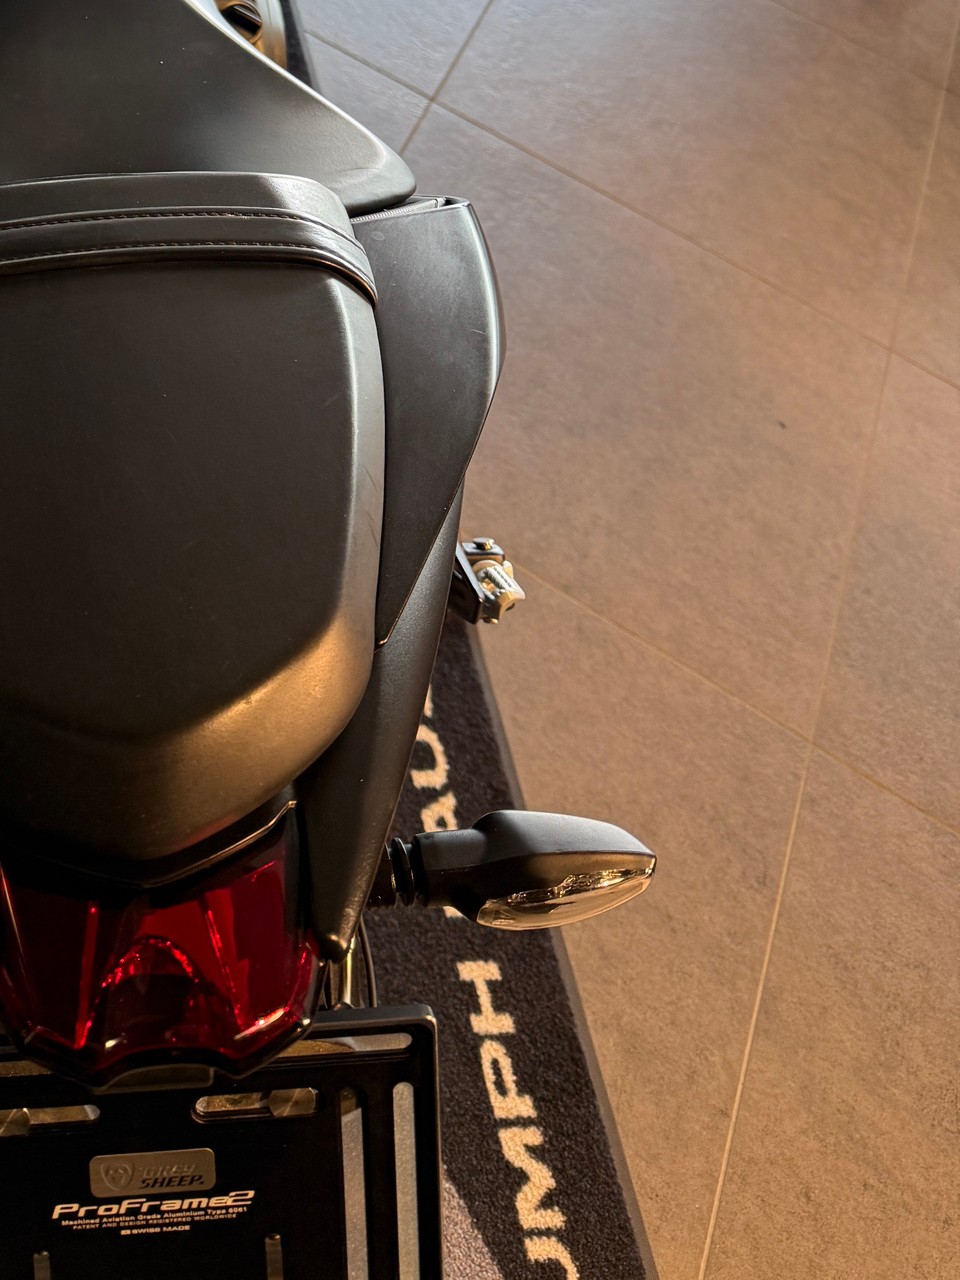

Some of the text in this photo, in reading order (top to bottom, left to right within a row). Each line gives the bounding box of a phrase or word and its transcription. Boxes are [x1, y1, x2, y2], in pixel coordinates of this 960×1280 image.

[51, 1190, 255, 1219] ProFrame2
[61, 1218, 100, 1226] Machined
[102, 1215, 136, 1223] Aviation
[163, 1210, 205, 1218] Aluminium
[207, 1208, 227, 1216] Type
[120, 1219, 146, 1227] DESIGN
[148, 1216, 192, 1225] REGISTERED
[193, 1213, 238, 1221] WORLDWIDE
